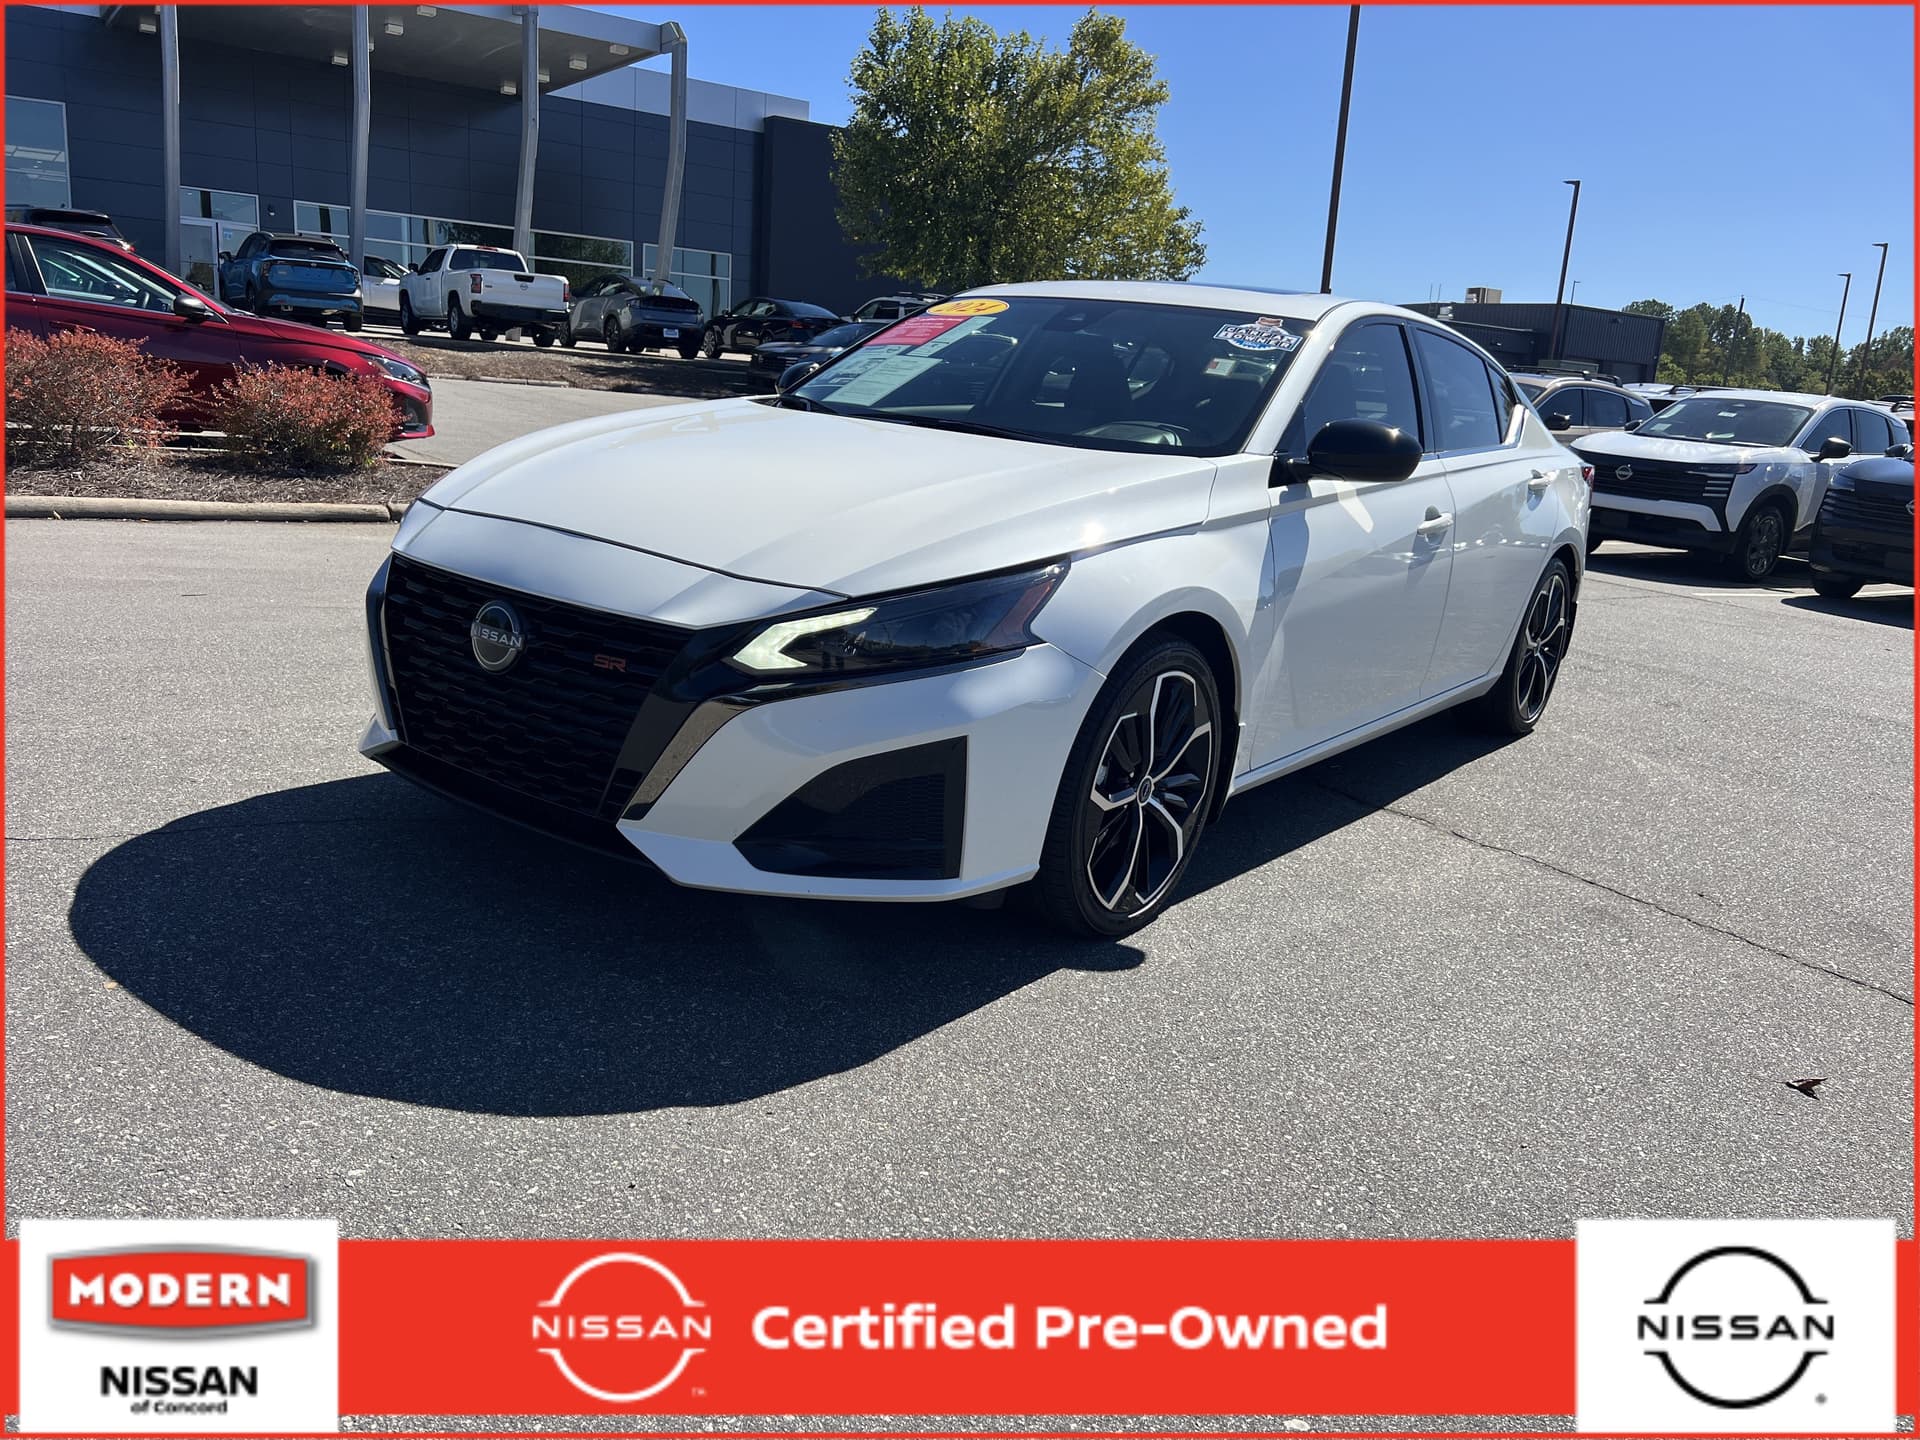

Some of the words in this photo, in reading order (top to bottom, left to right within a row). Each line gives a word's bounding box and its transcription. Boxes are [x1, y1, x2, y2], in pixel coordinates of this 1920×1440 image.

[1225, 326, 1296, 344] CARFAX
[1233, 334, 1292, 349] OWNER
[471, 622, 522, 648] NISSAN
[593, 654, 627, 672] SR
